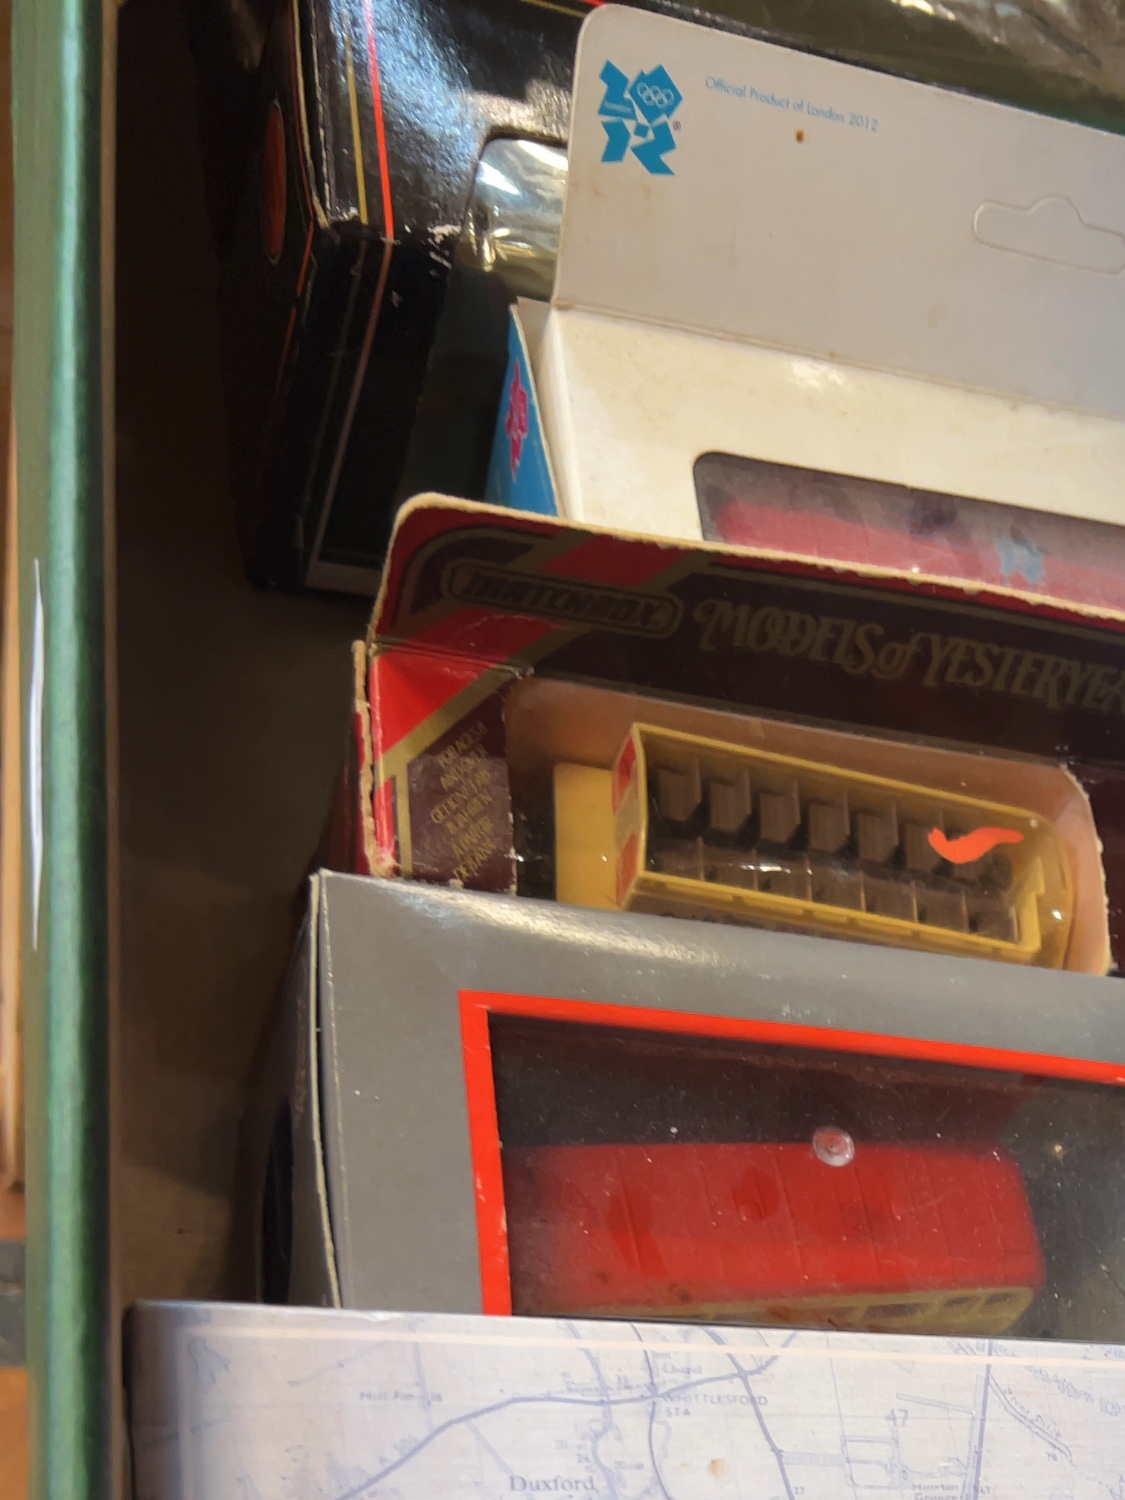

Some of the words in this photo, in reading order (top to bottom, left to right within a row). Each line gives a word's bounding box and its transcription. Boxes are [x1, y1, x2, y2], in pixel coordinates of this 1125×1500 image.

[705, 76, 746, 98] Official
[750, 87, 790, 108] Product
[793, 100, 804, 112] of
[807, 102, 845, 122] London
[849, 112, 878, 133] 2012
[693, 600, 884, 679] MODELS
[884, 1408, 909, 1428] 47
[509, 1475, 596, 1493] Duxford
